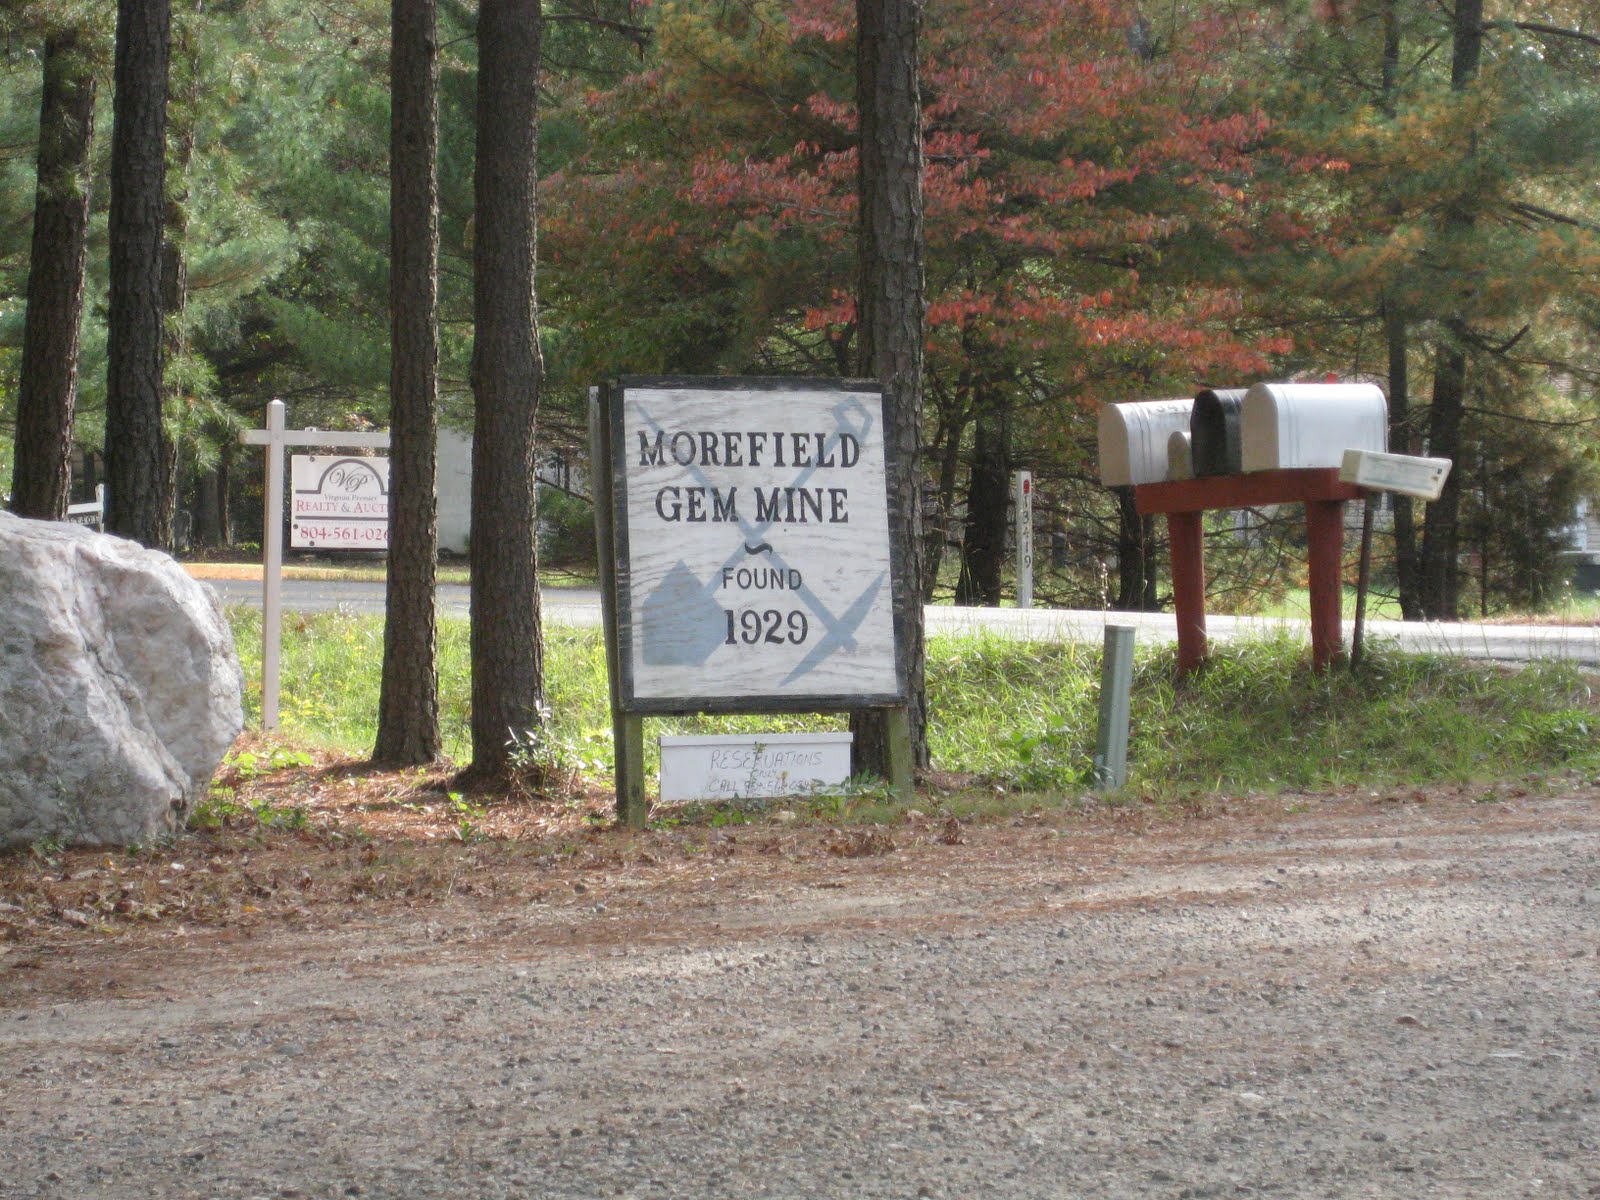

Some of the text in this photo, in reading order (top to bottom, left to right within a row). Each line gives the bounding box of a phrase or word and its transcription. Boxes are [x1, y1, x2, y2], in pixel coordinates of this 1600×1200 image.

[638, 430, 860, 468] MOREFIELD
[296, 500, 388, 513] REALTY & AUCT
[655, 485, 849, 523] GEM MINE
[722, 567, 802, 590] FOUND
[724, 609, 808, 645] 1929
